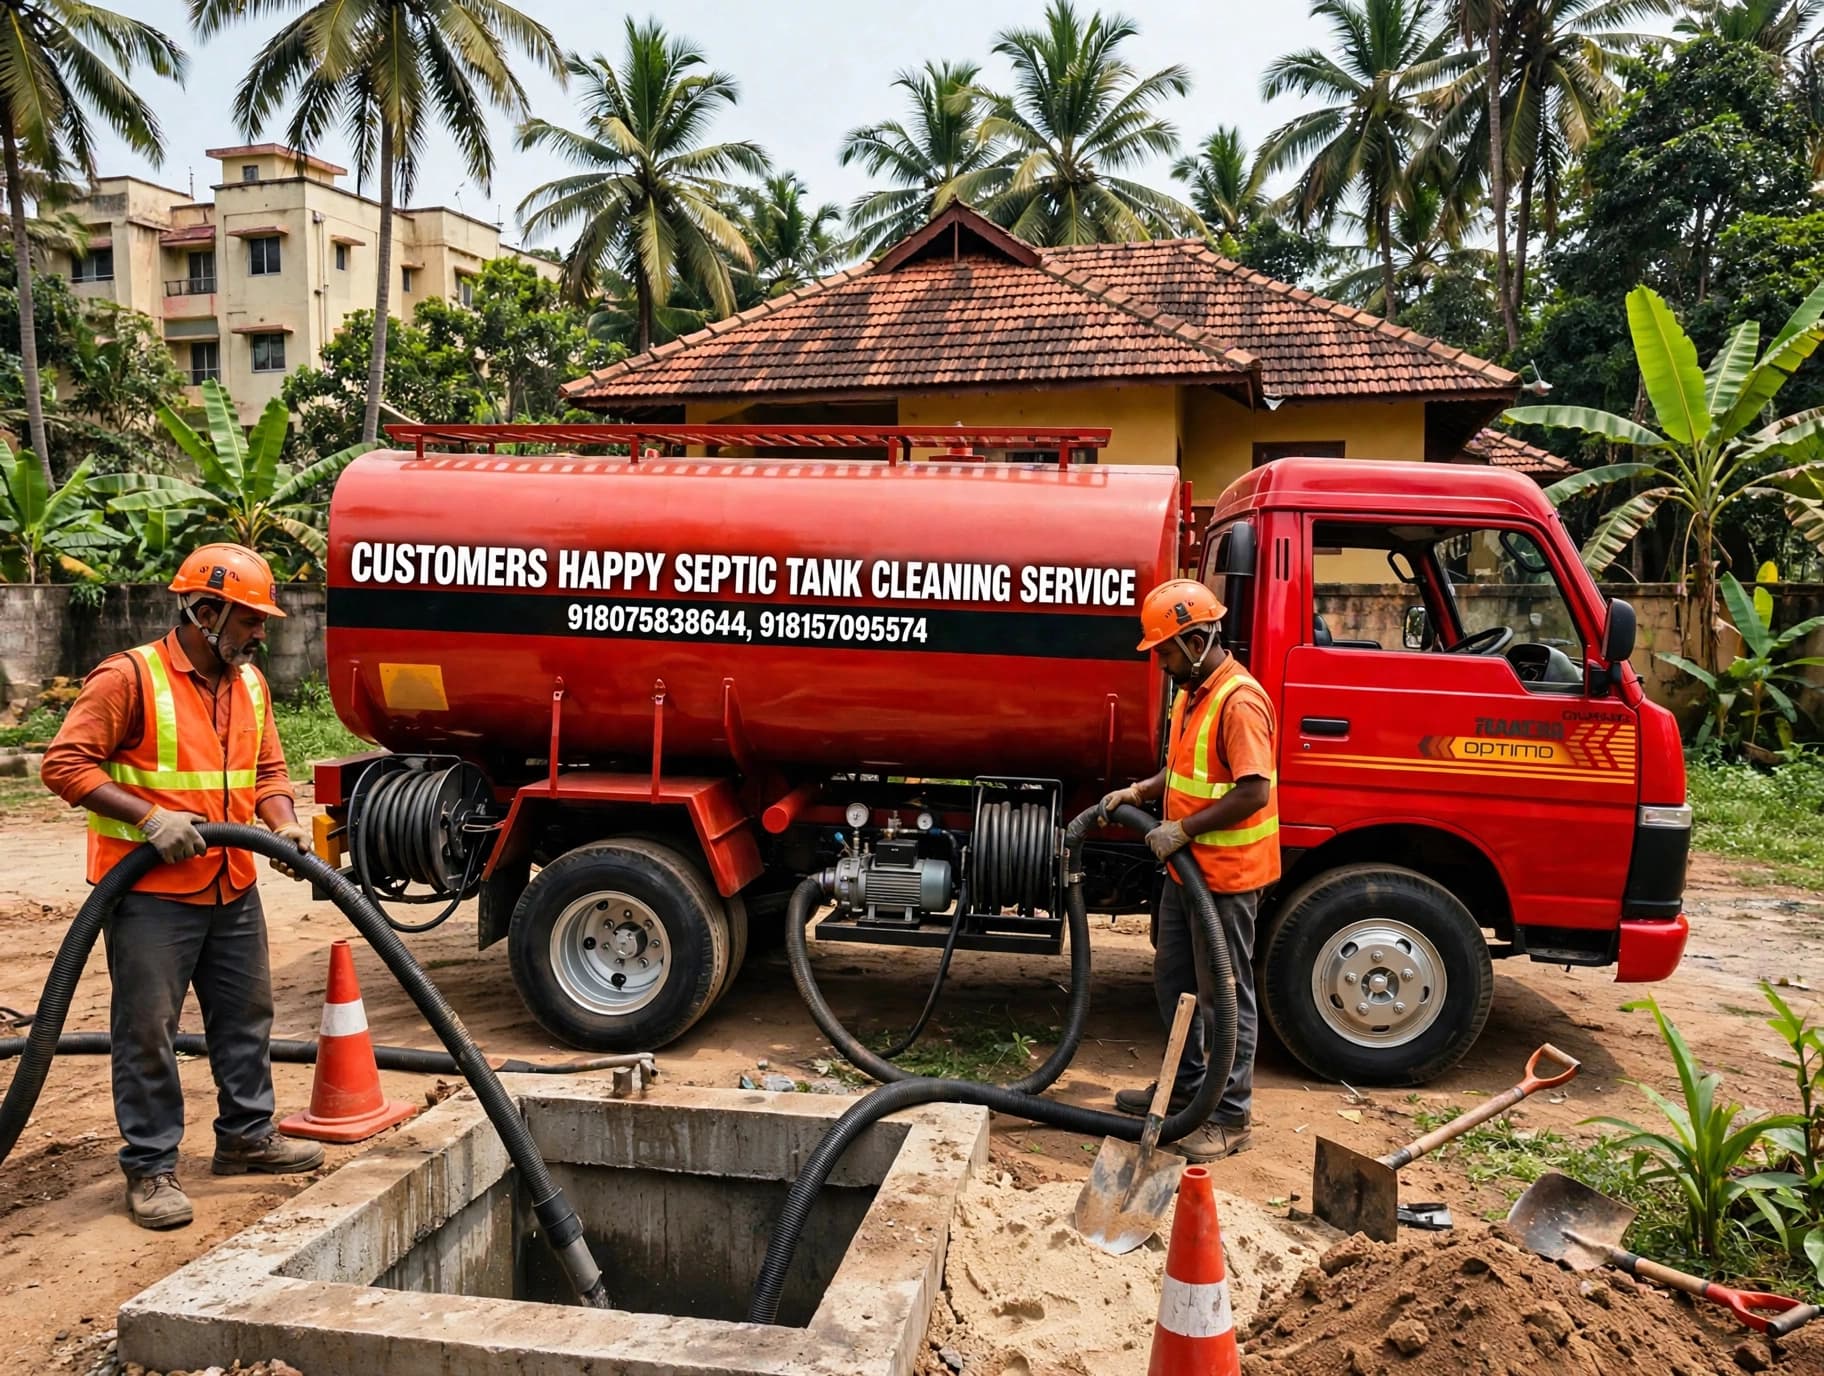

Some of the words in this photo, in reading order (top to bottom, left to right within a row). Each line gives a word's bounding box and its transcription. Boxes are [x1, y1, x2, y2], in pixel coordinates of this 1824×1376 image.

[351, 541, 548, 588] CUSTOMERS
[558, 549, 666, 591] HAPPY
[674, 553, 777, 595] SEPTIC
[785, 557, 864, 598] TANK
[871, 559, 1011, 602] CLEANING
[1020, 565, 1136, 606] SERVICE
[568, 603, 753, 642] 918075838644,
[759, 611, 928, 643] 918157095574
[1464, 741, 1554, 759] OPTIMO
